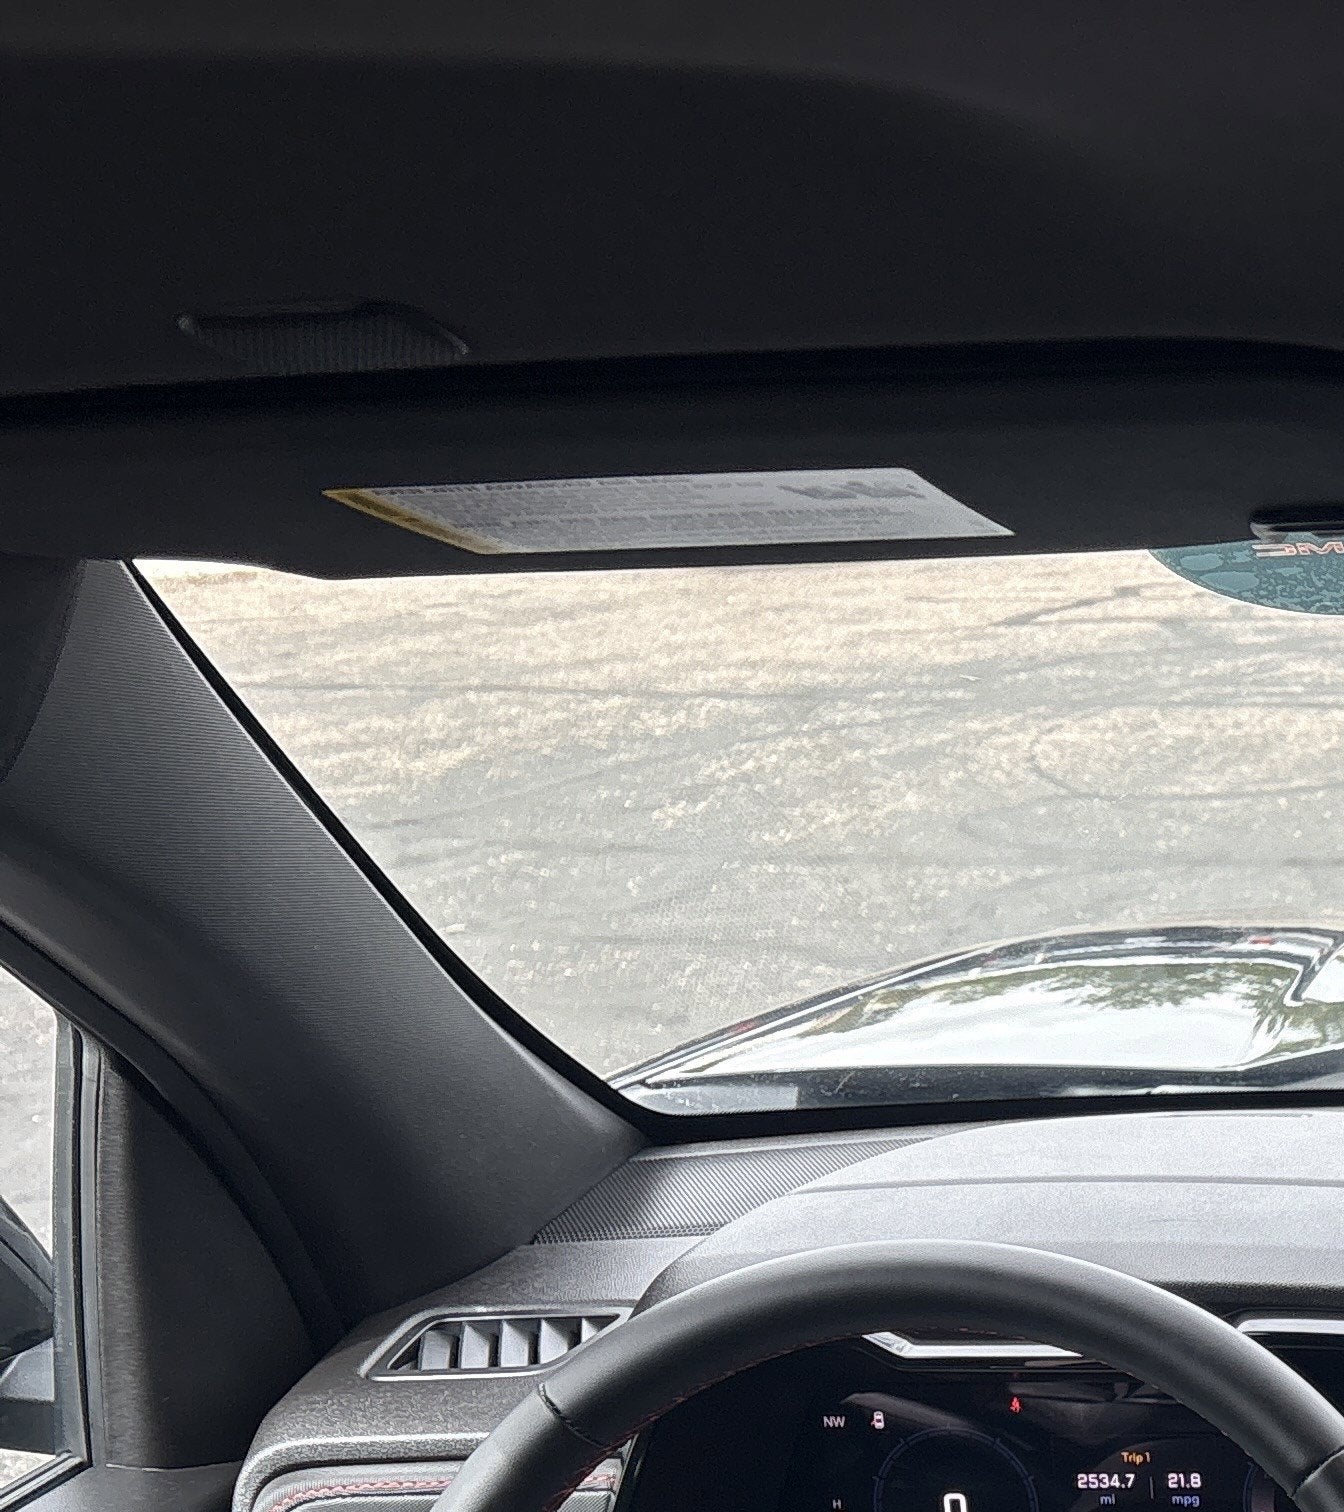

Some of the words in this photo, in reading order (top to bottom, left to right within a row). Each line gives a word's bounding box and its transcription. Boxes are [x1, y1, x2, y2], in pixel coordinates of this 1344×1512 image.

[823, 1416, 845, 1428] NW
[1121, 1451, 1143, 1465] Trip
[1145, 1451, 1151, 1462] 1
[1077, 1473, 1135, 1489] 2534.7
[1167, 1473, 1201, 1488] 21.8
[1100, 1493, 1115, 1505] mi
[1171, 1493, 1200, 1507] mpg
